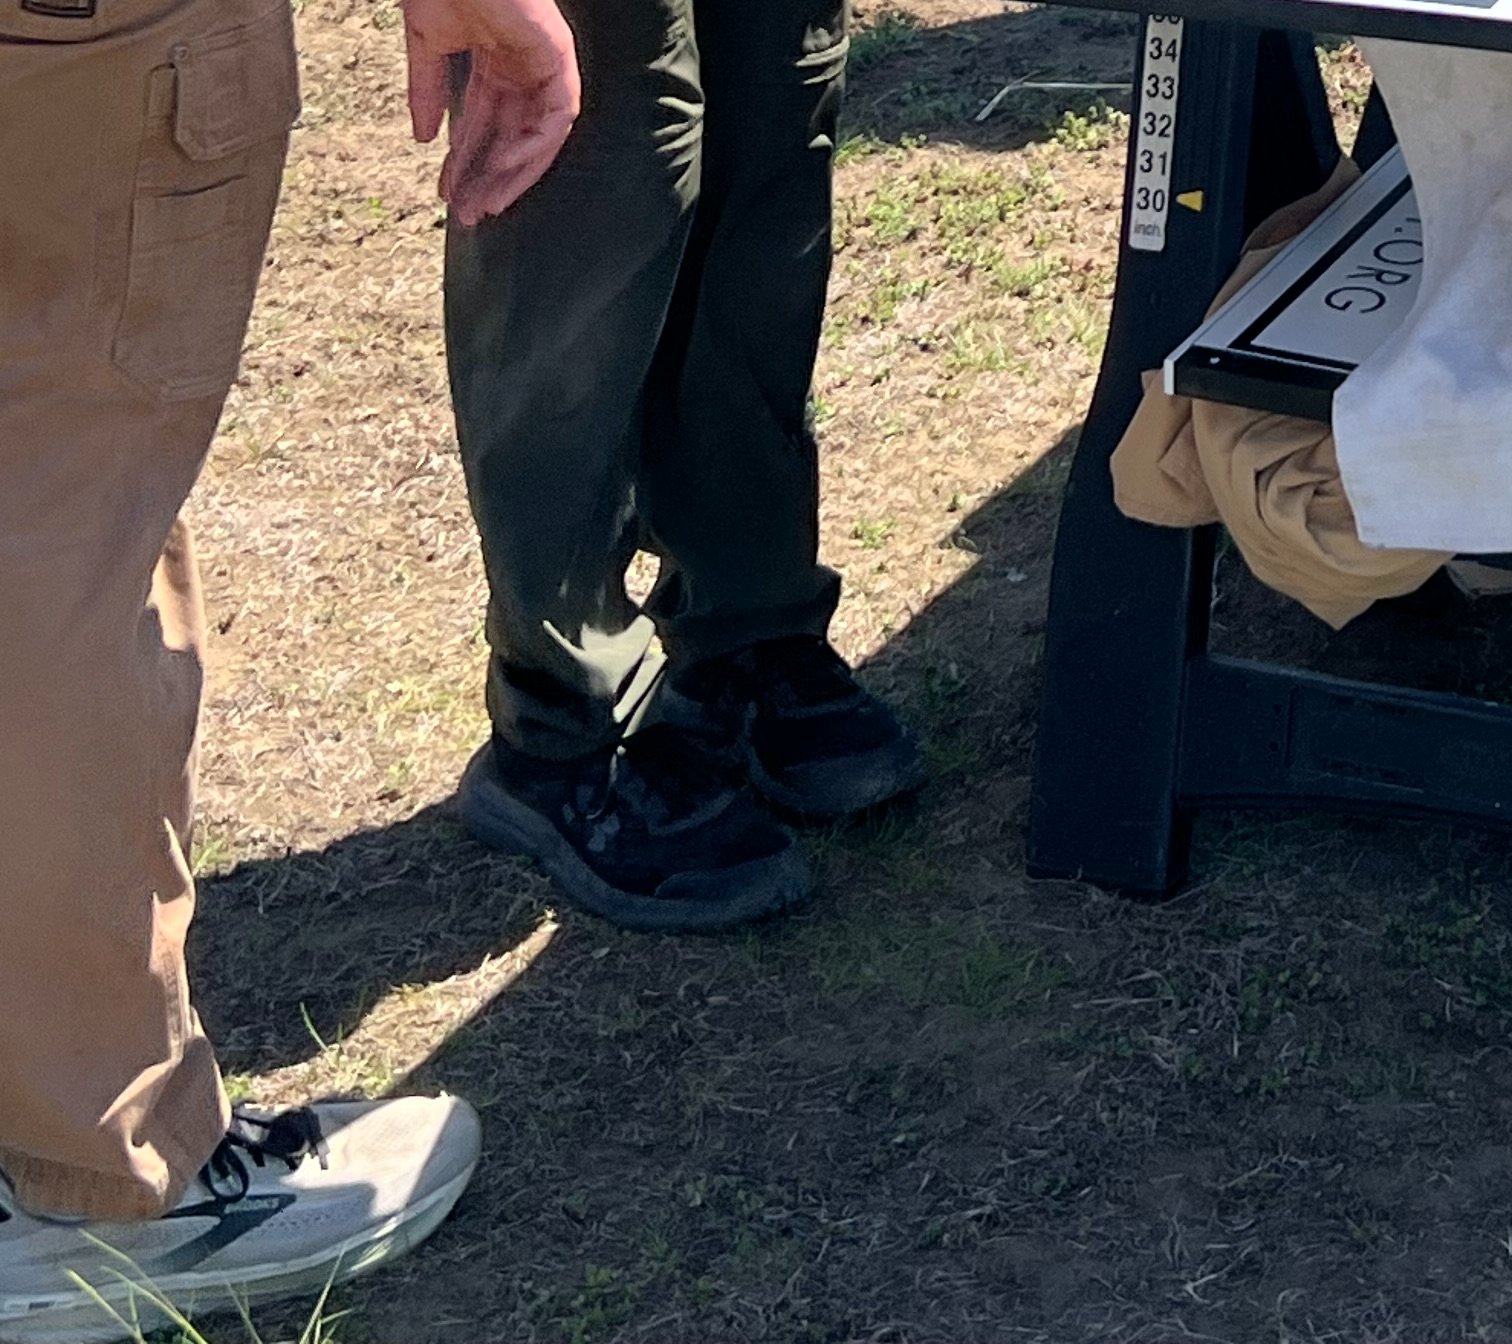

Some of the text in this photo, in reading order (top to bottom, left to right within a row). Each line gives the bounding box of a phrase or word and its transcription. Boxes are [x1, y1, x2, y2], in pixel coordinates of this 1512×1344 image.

[1149, 37, 1178, 63] 34
[1146, 73, 1175, 101] 33
[1142, 111, 1172, 138] 32
[1139, 149, 1167, 176] 31
[1136, 187, 1166, 213] 30
